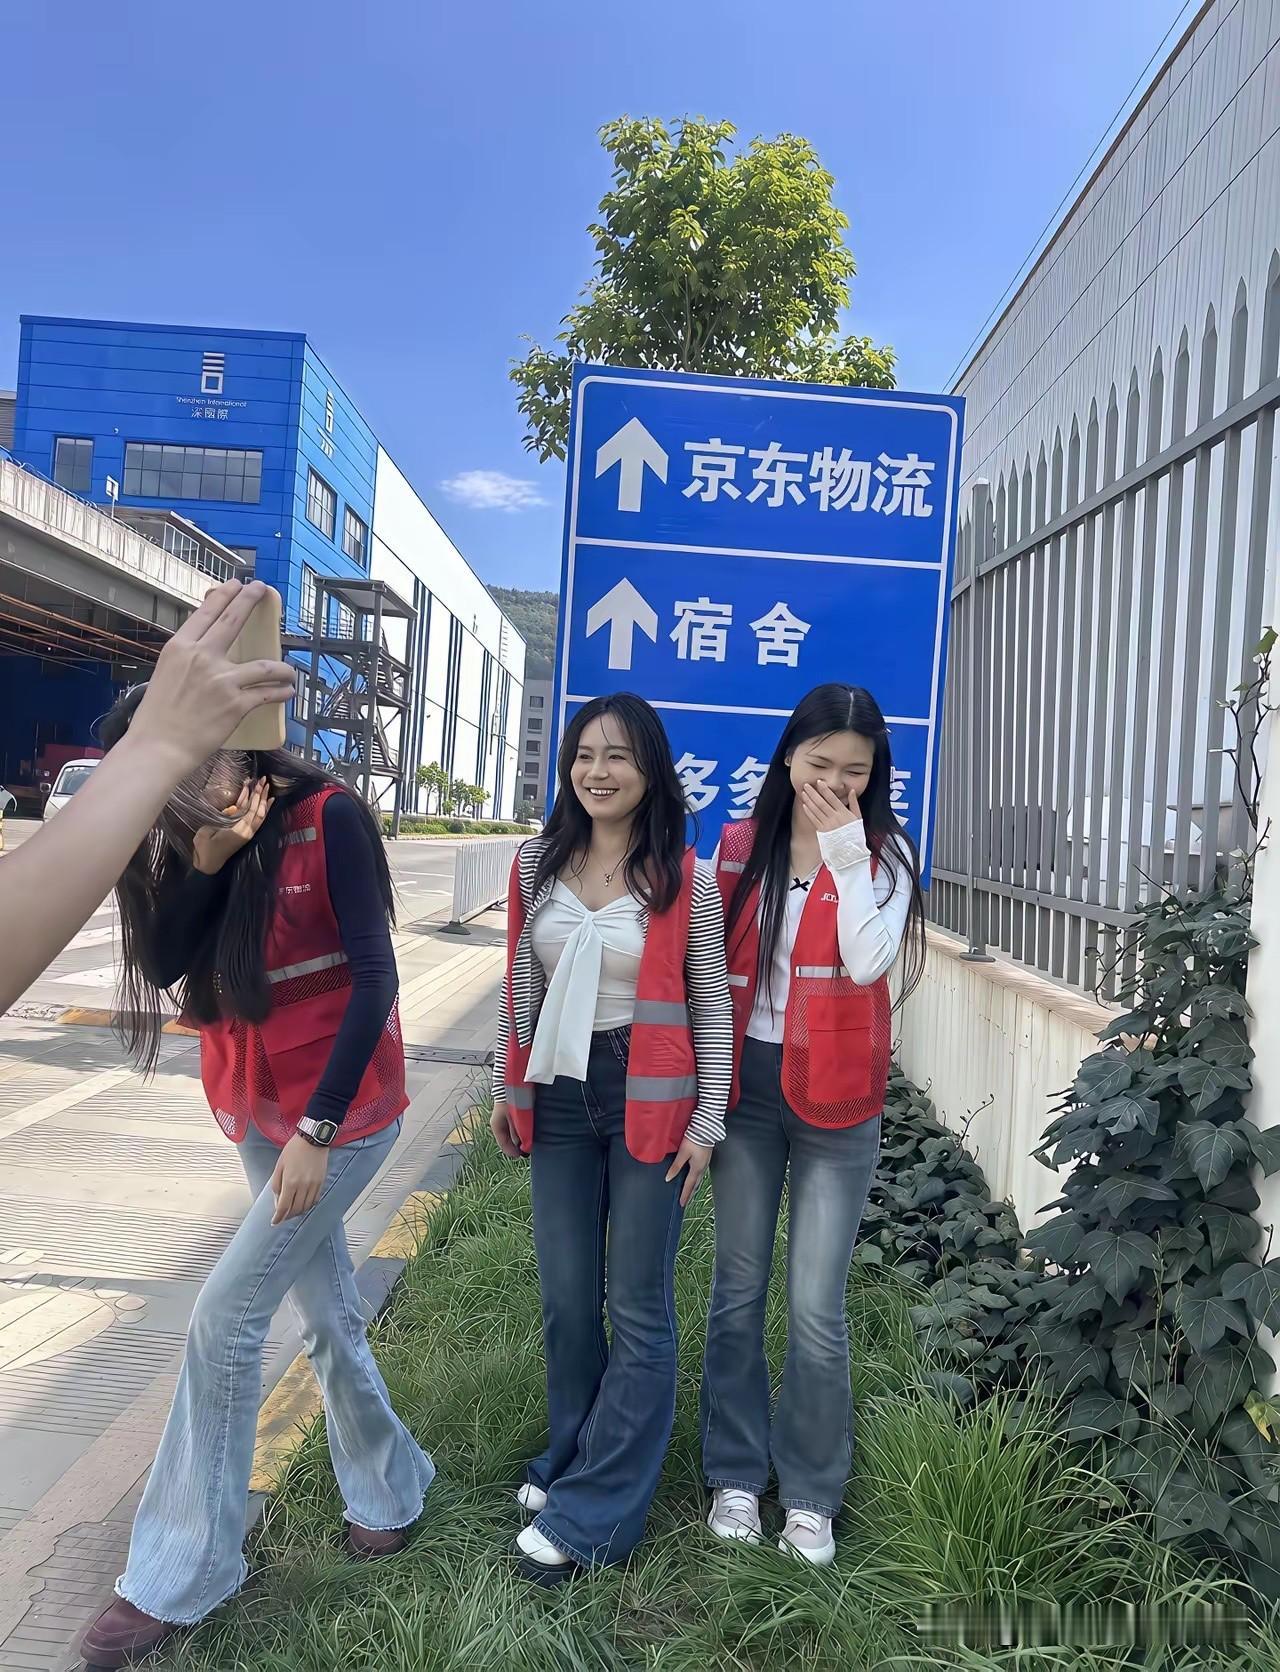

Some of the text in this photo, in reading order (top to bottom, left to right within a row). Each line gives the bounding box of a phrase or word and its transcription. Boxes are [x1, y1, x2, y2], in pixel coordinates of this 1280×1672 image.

[681, 437, 936, 518] 京东物流
[669, 596, 812, 669] 宿舍
